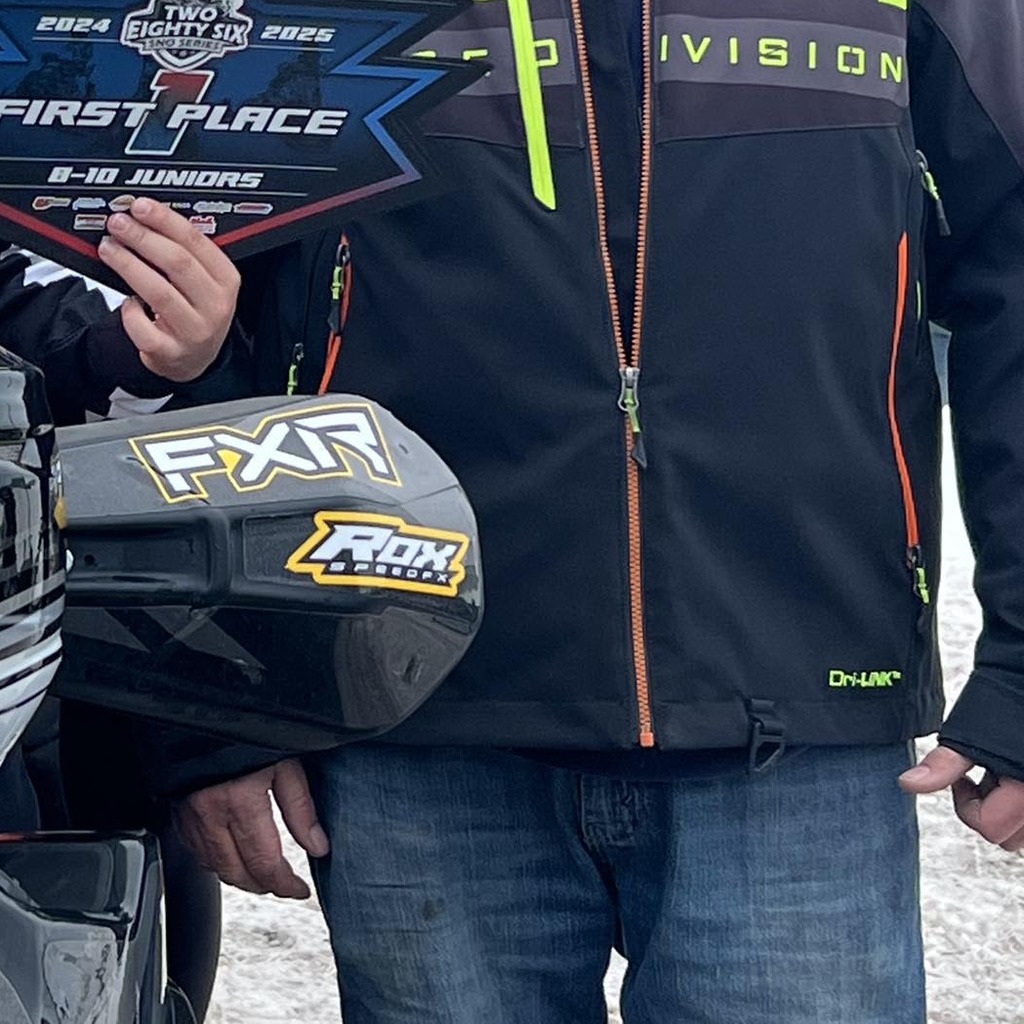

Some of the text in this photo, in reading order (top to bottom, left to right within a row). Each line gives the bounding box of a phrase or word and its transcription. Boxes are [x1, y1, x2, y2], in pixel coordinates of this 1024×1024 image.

[164, 5, 218, 22] TWO
[37, 17, 110, 34] 2024
[126, 20, 246, 43] EIGHTY SIX
[261, 25, 336, 43] 2025
[166, 103, 348, 135] PLACE
[47, 167, 264, 189] 8-10 JUNIORS
[144, 410, 391, 492] FXR
